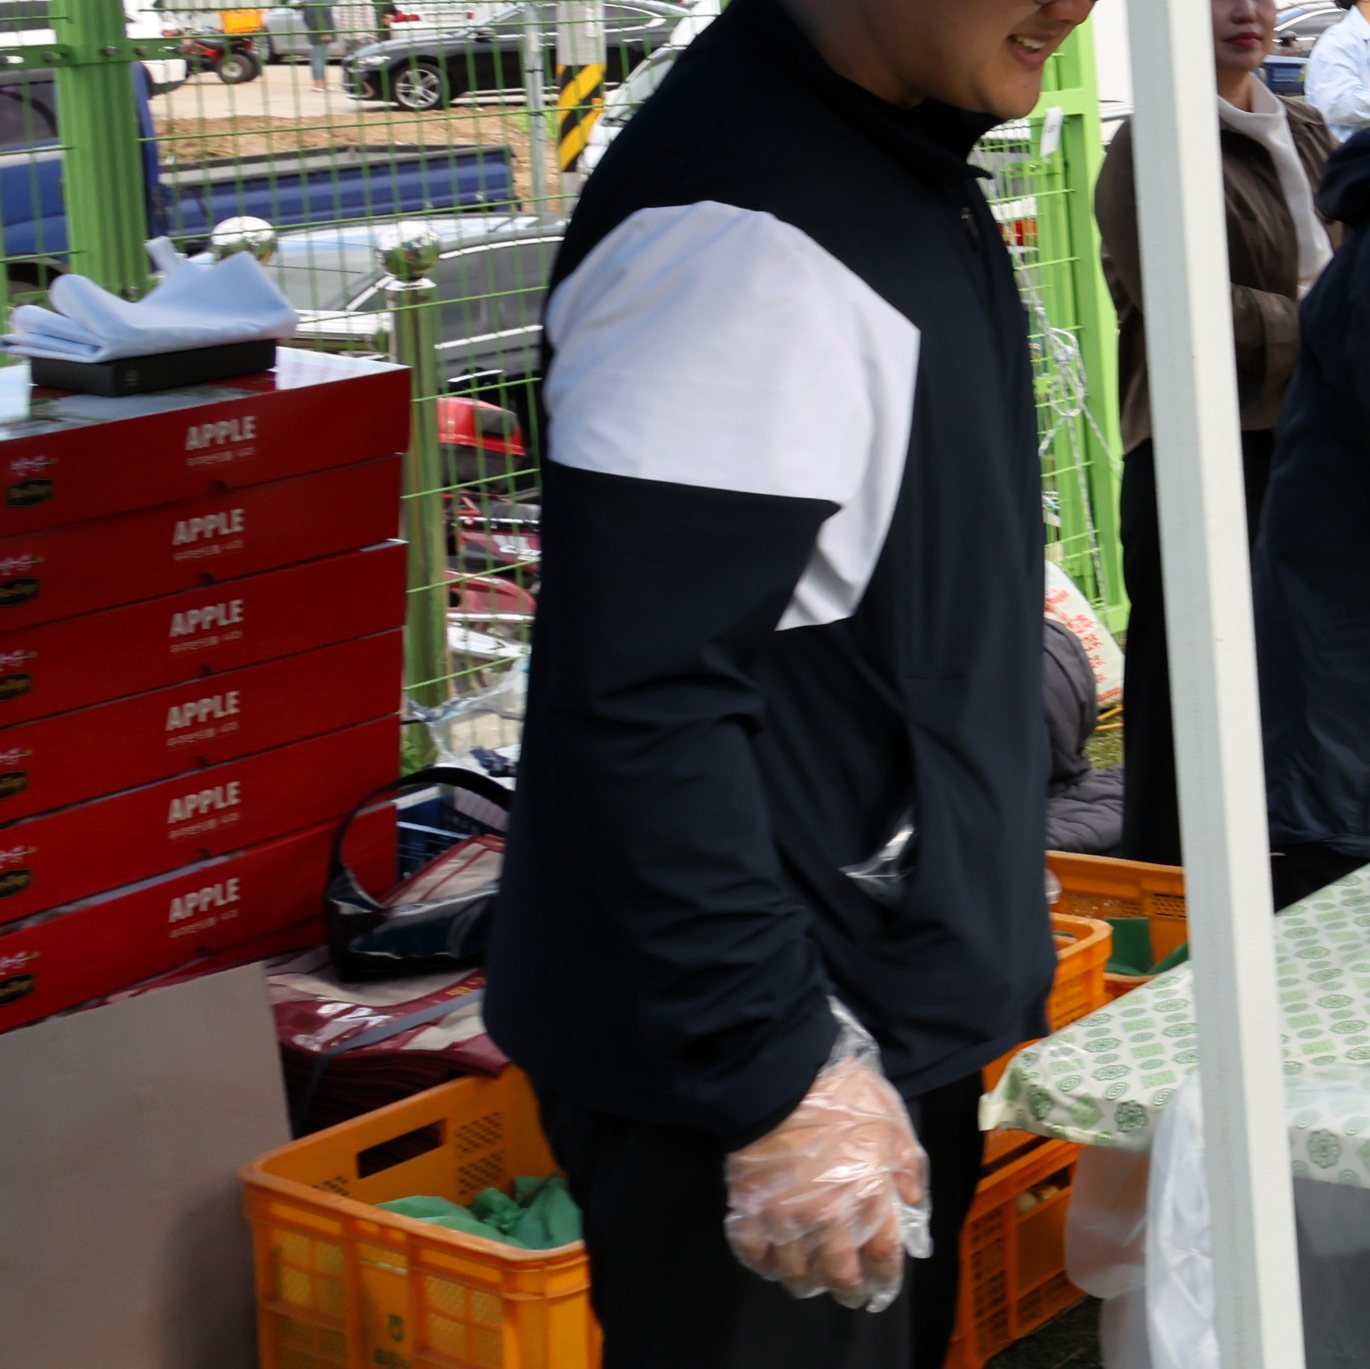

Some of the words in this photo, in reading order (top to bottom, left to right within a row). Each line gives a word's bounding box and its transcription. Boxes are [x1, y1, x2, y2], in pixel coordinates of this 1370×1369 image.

[185, 416, 256, 450] APPLE
[172, 509, 244, 545] APPLE
[169, 600, 243, 637] APPLE
[165, 691, 240, 731] APPLE
[167, 782, 241, 824] APPLE
[168, 878, 240, 923] APPLE
